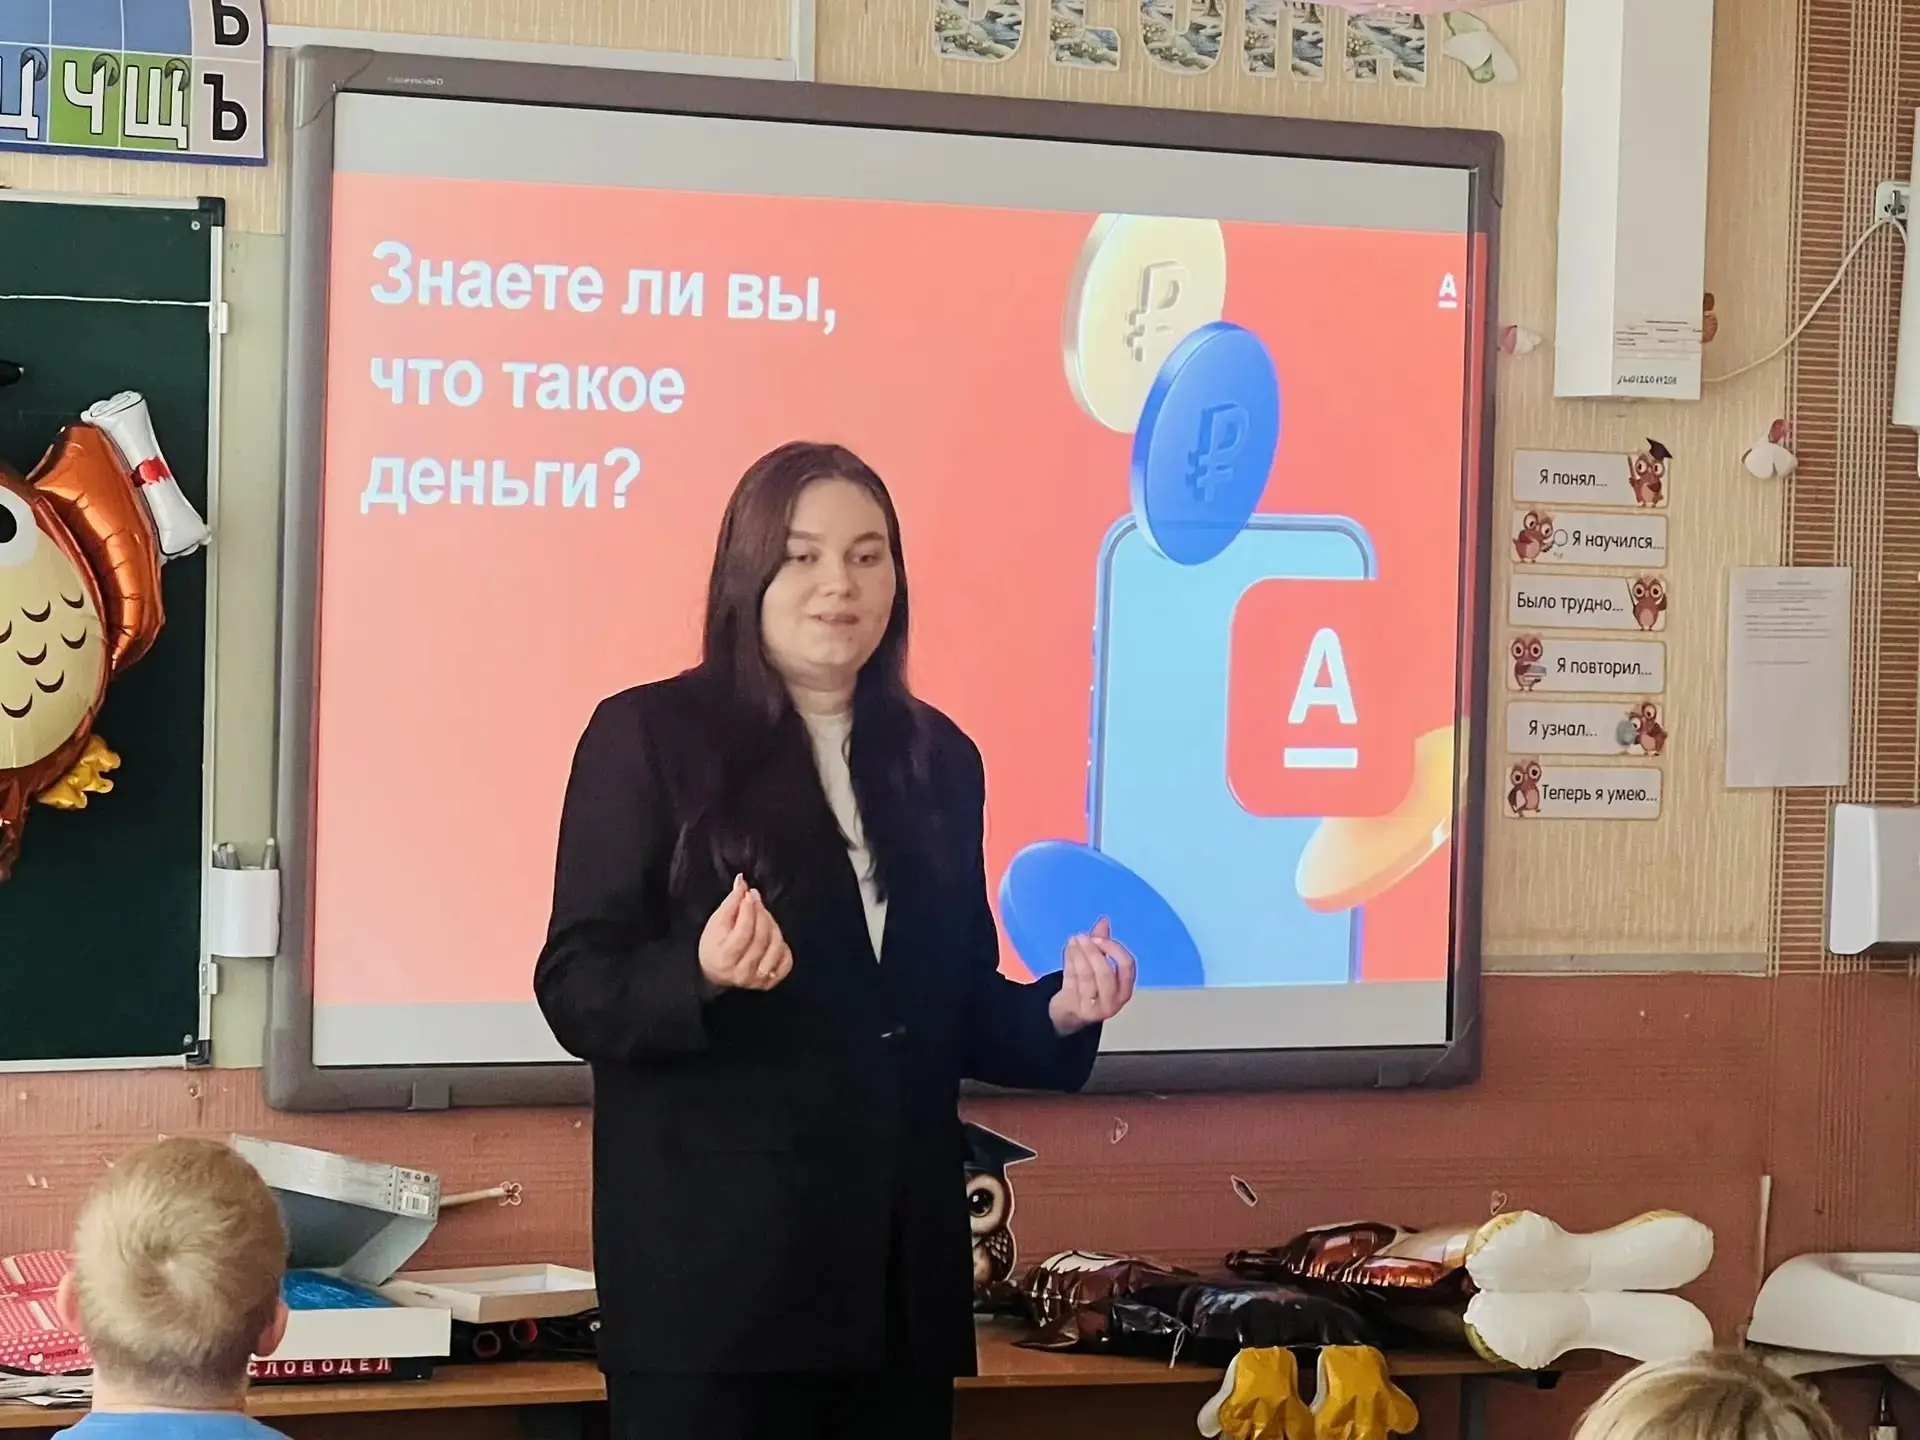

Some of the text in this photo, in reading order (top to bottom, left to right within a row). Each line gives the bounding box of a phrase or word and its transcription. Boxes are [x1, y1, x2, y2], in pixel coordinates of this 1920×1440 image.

[63, 59, 107, 134] Ч
[124, 64, 189, 150] Щ
[203, 73, 248, 140] Ъ
[370, 240, 836, 335] Знаете ли вы,
[370, 357, 685, 414] что такое
[361, 447, 641, 514] деньги?
[1539, 469, 1608, 487] Я понял...
[1572, 530, 1665, 551] Я научился...
[1517, 592, 1624, 614] Было трудно...
[1557, 657, 1653, 678] Я повторил...
[1528, 719, 1598, 740] Я узнал...
[1542, 784, 1658, 804] Теперь я умею...
[246, 1357, 392, 1377] СЛОВОДЕЛ
